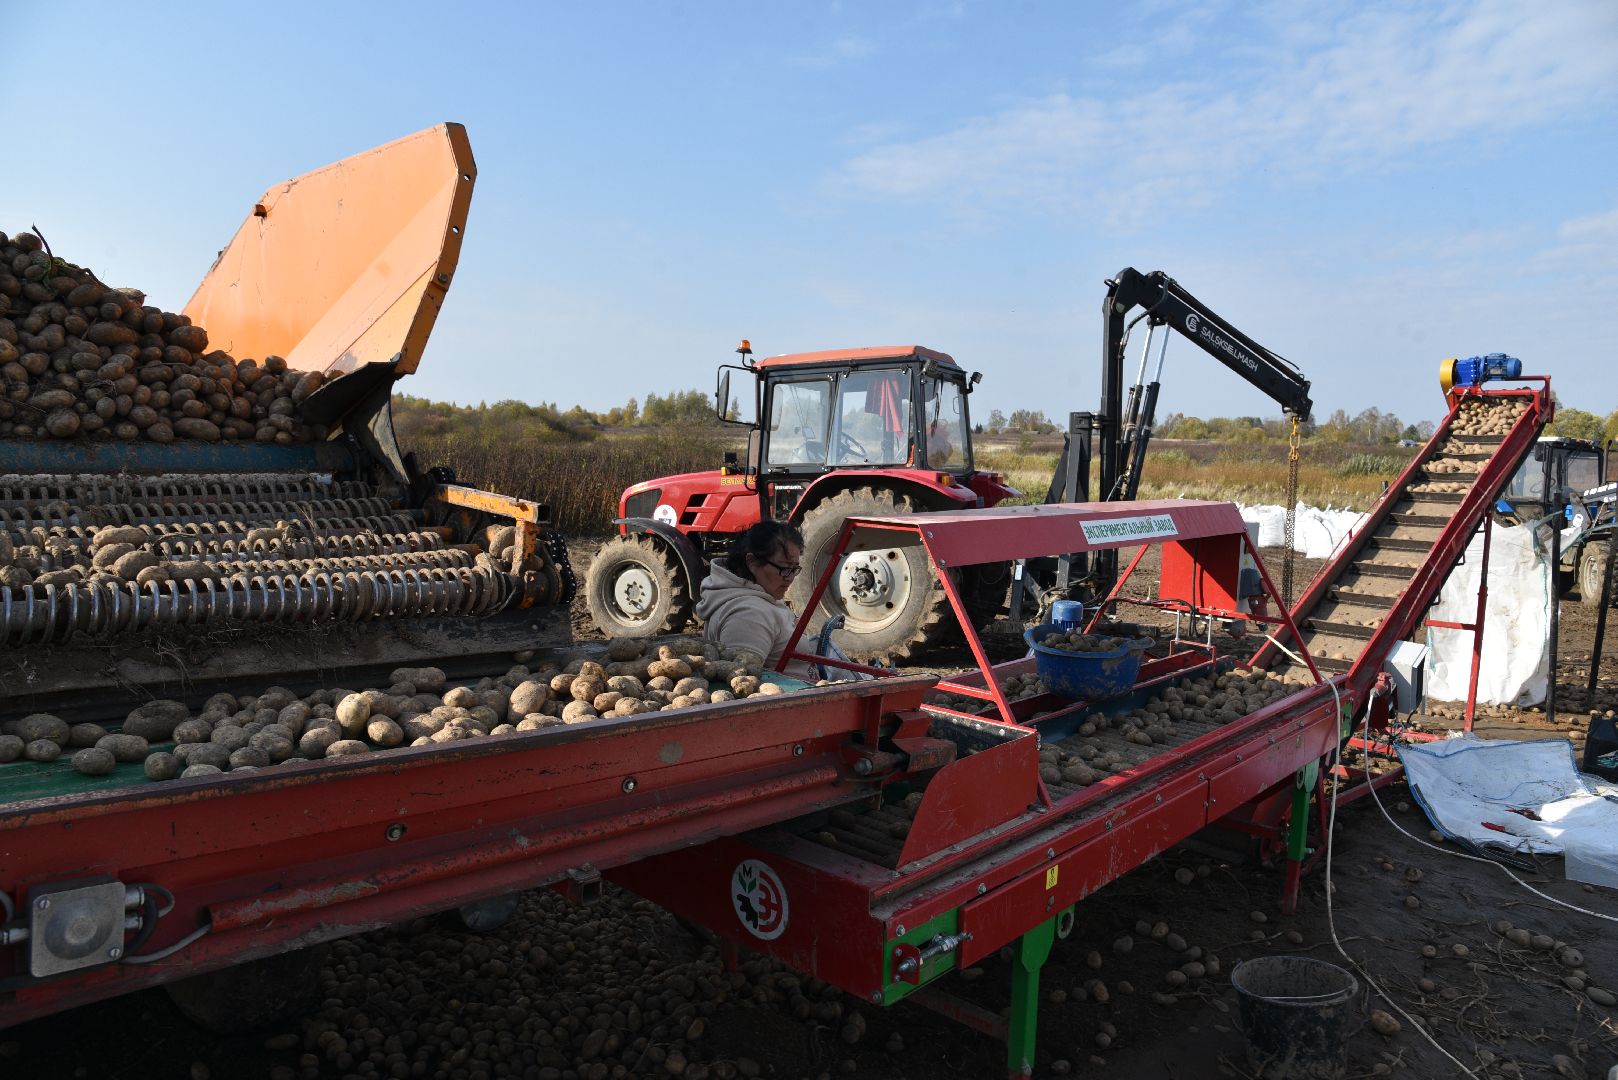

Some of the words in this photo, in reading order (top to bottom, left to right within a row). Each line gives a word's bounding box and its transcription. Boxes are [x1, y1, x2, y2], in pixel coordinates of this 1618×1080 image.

[1201, 326, 1258, 372] SALSKSELMASH
[1083, 516, 1155, 539] ЭКСПЕРИМЕНТАЛЬНЫЙ
[1153, 518, 1176, 532] ЗАВОД
